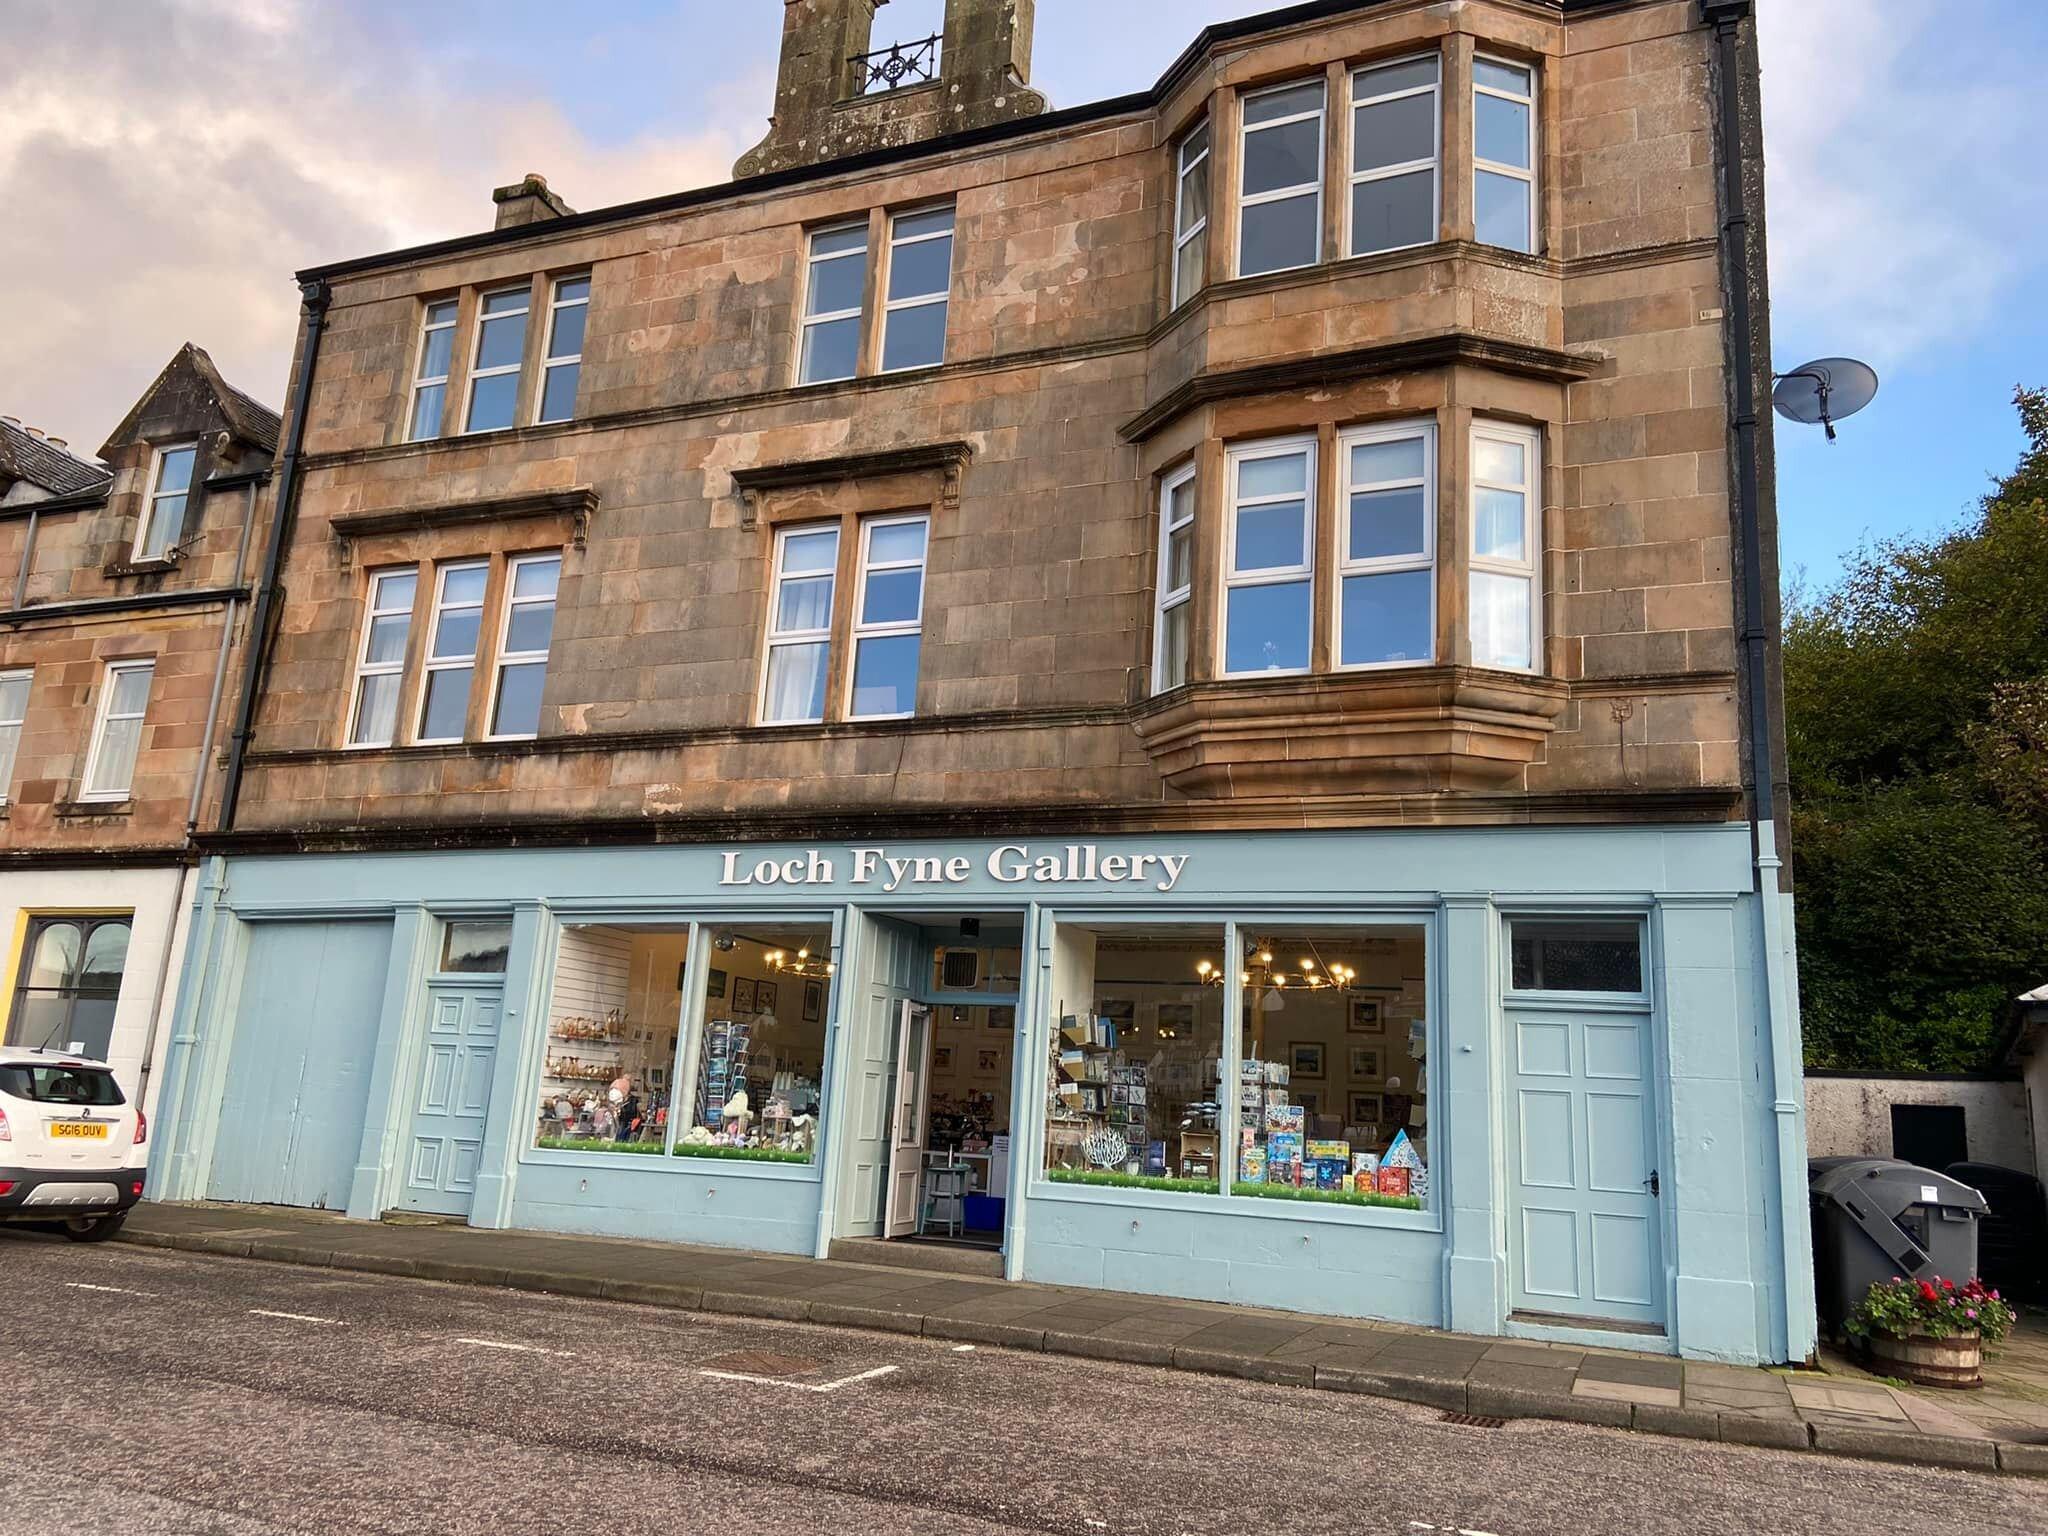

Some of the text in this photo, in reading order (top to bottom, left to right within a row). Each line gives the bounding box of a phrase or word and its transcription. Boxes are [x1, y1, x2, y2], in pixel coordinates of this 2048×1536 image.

[718, 845, 1191, 892] Loch Fyne Gallery
[58, 1124, 102, 1136] SG16 OUV
